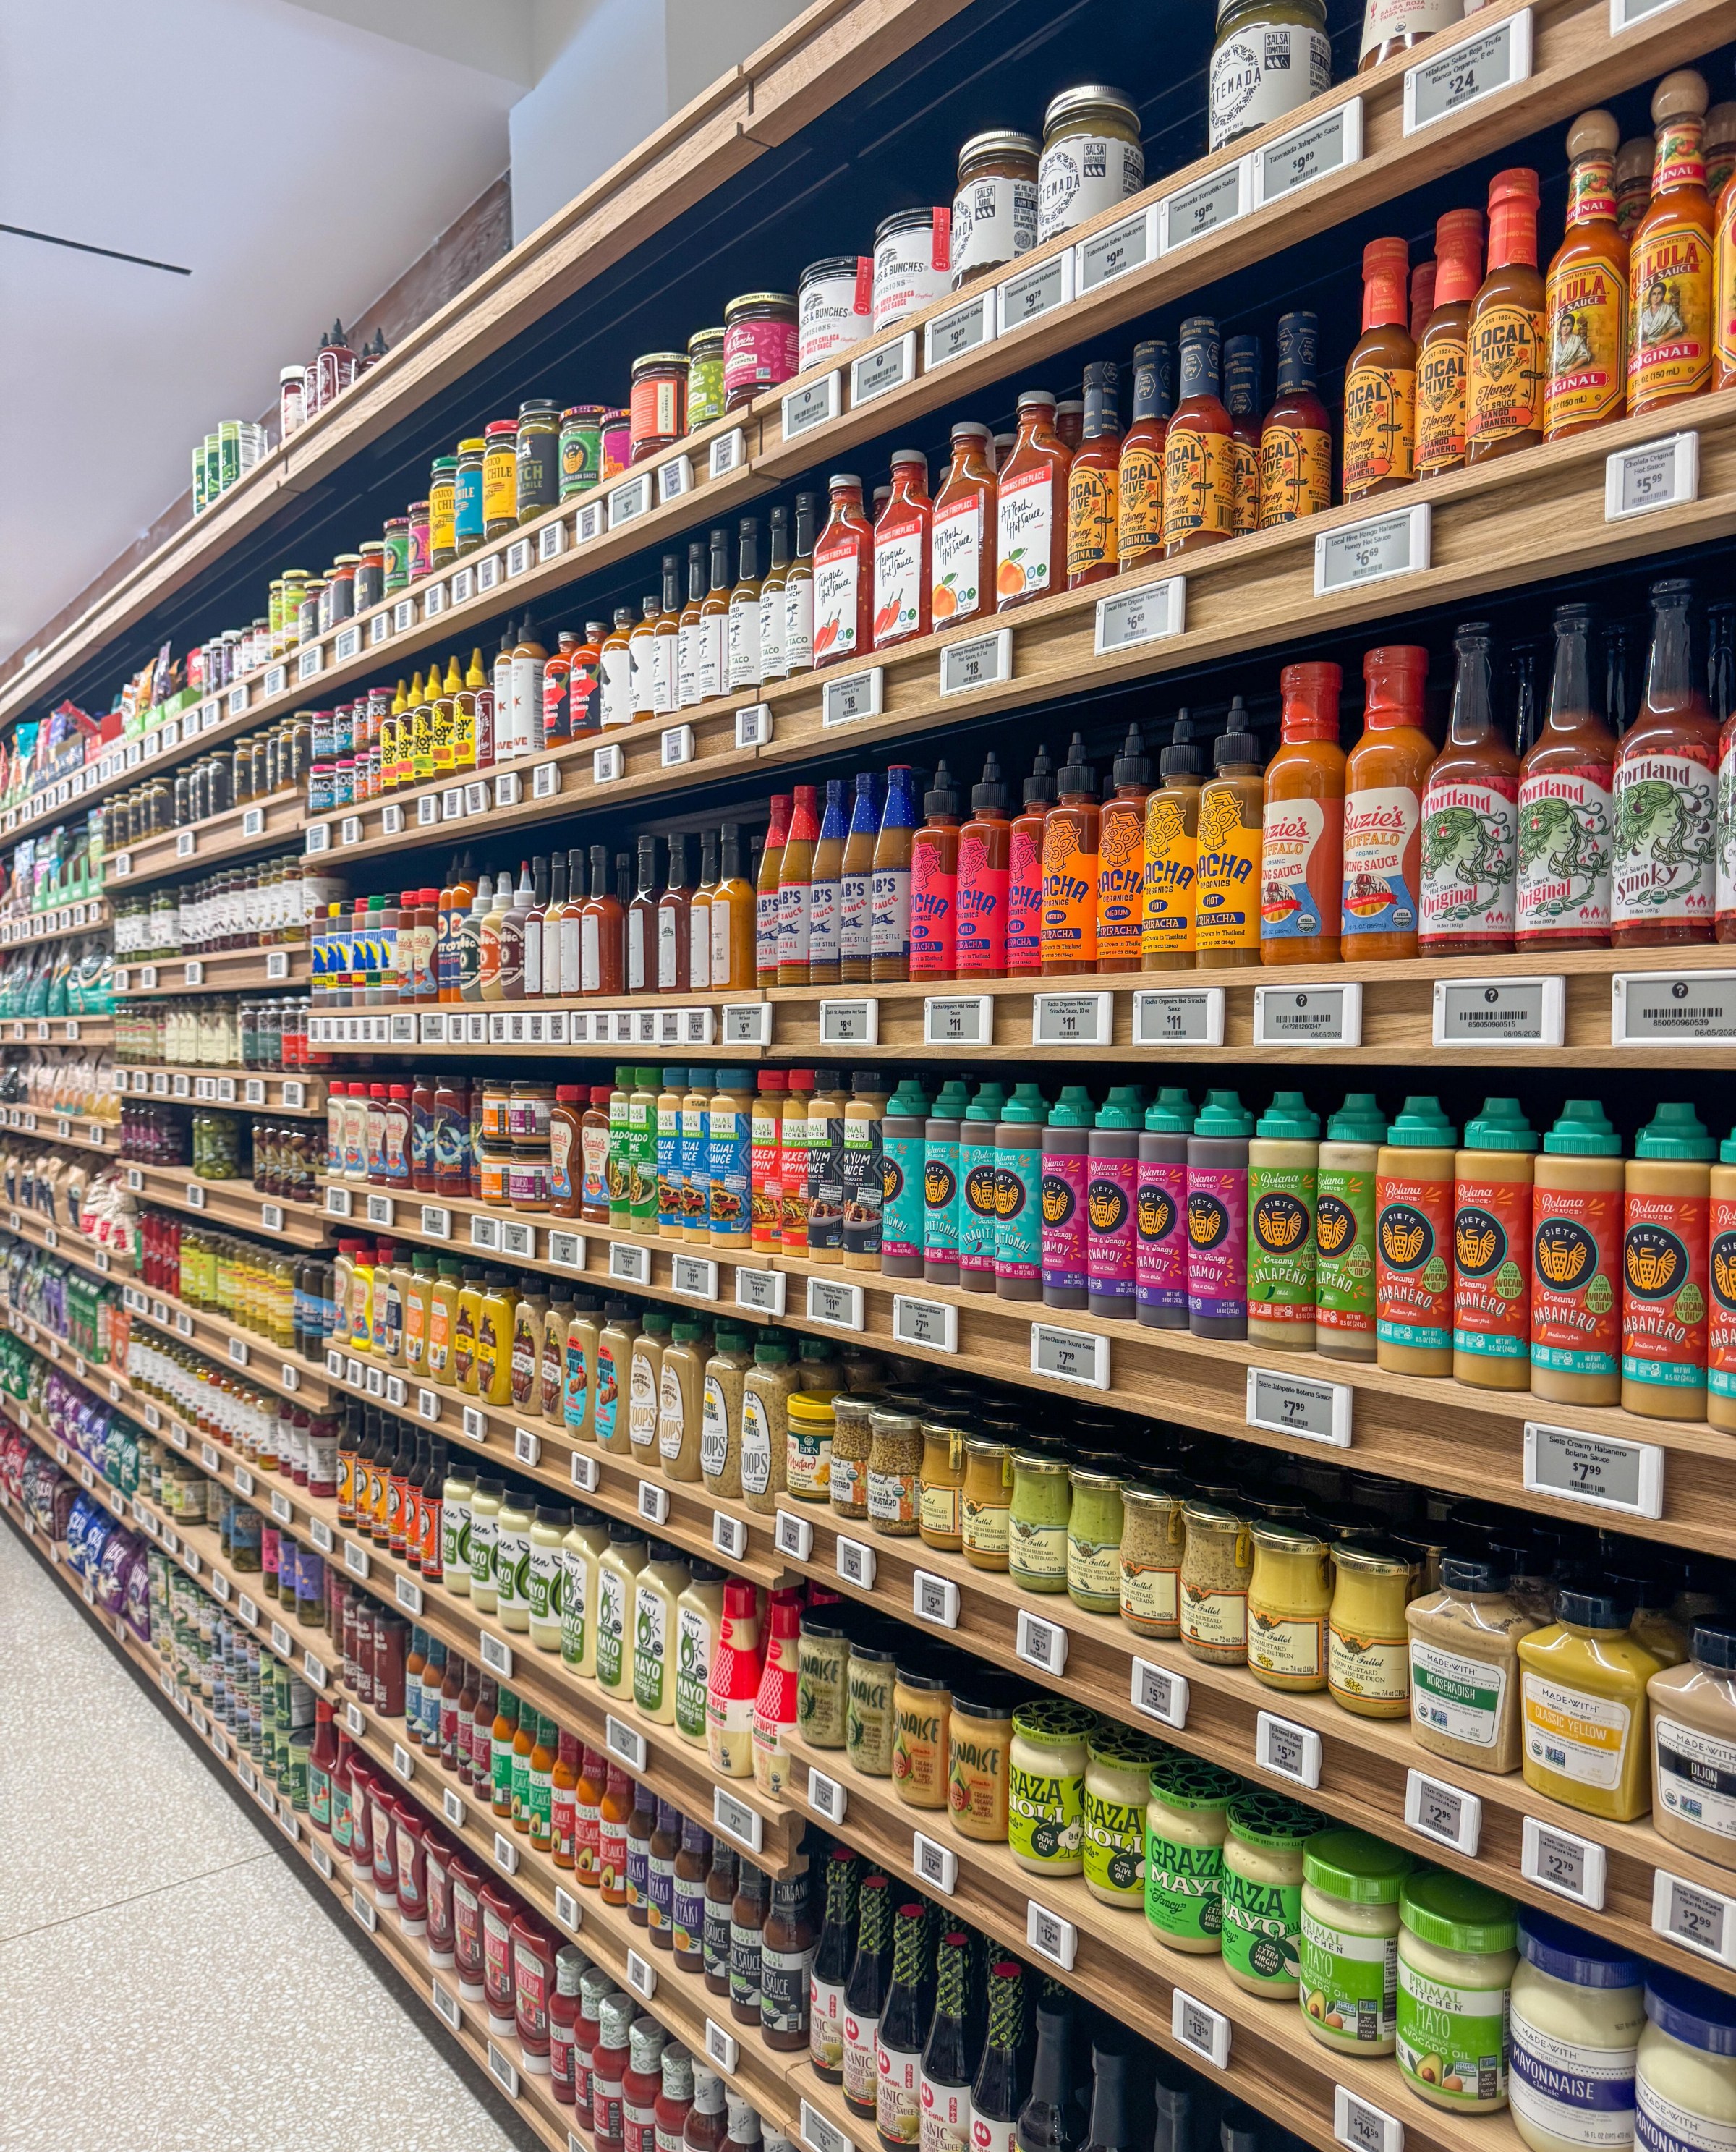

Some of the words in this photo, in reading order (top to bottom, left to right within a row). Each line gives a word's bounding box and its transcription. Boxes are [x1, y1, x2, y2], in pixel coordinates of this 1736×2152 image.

[1380, 4, 1404, 15] SALSA
[1267, 33, 1289, 46] SALSA
[1267, 46, 1289, 55] TOMATILLO
[1426, 61, 1450, 79] Milaluna
[1452, 54, 1468, 66] Salsa
[1469, 45, 1483, 56] Roja
[1485, 35, 1502, 48] Trufa
[1432, 71, 1452, 85] Blanca
[1453, 57, 1479, 74] Organic,
[1449, 69, 1474, 95] $24
[1086, 145, 1105, 156] SALSA
[1269, 144, 1297, 164] Tatemada
[1298, 132, 1323, 152] Jalapeño
[1324, 123, 1340, 139] Salsa
[977, 187, 994, 199] SALSA
[1173, 195, 1198, 213] Tatemada
[1199, 184, 1222, 203] Tomatillo
[1222, 177, 1236, 191] Salsa
[1086, 244, 1108, 259] Tatemada
[1108, 237, 1122, 250] Salsa
[1122, 224, 1145, 242] Molcajete
[1666, 237, 1690, 247] MEXICO
[889, 262, 924, 275] BUNCHES
[1008, 284, 1028, 299] Tatemada
[1039, 267, 1060, 283] Habanero
[1637, 278, 1656, 297] HOT
[1657, 264, 1692, 281] SAUCE
[815, 307, 848, 319] BUNCHES
[1549, 310, 1565, 328] HOT
[1567, 296, 1599, 311] SAUCE
[934, 320, 956, 336] Tatemada
[956, 312, 970, 326] Arbol
[970, 307, 984, 319] Salsa
[1473, 324, 1531, 357] LOCAL
[1481, 344, 1516, 363] HIVE
[1628, 344, 1691, 375] ORIGINAL
[1418, 357, 1467, 389] LOCAL
[1425, 375, 1455, 396] HIVE
[1476, 383, 1518, 406] Honey
[1348, 401, 1374, 420] HIVE
[1492, 399, 1517, 410] SAUCE
[1481, 408, 1510, 421] MANGO
[1420, 413, 1457, 436] Honey
[1475, 416, 1518, 432] HABANERO
[1419, 444, 1457, 462] HABANERO
[1625, 457, 1646, 469] Cholula
[1648, 448, 1675, 462] Original
[487, 466, 512, 480] CHILE
[1646, 460, 1666, 472] Sauce
[522, 480, 542, 490] CHILE
[1000, 480, 1018, 495] SPRINGS
[1018, 470, 1045, 487] FIREPLACE
[1119, 464, 1158, 489] LOCAL
[1122, 480, 1146, 497] HIVE
[934, 509, 949, 523] SPRINGS
[949, 499, 974, 515] FIREPLACE
[892, 523, 916, 538] FIREPLACE
[1331, 537, 1345, 547] Local
[1359, 529, 1378, 540] Mango
[1379, 522, 1407, 534] Habanero
[1118, 535, 1153, 551] ORIGINAL
[1345, 542, 1361, 551] Honey
[1374, 534, 1392, 543] Sauce
[892, 556, 914, 577] Sauce
[1129, 605, 1143, 613] Sauce
[788, 636, 809, 646] TACO
[950, 650, 964, 659] Springs
[966, 661, 979, 676] $18
[845, 695, 855, 709] $18
[1615, 760, 1690, 794] Portland
[1520, 779, 1584, 805] Portland
[1424, 788, 1491, 819] Portland
[1343, 801, 1406, 835] Suzie's
[1345, 833, 1400, 853] BUFFALO
[1355, 849, 1380, 857] ORGANIC
[1272, 863, 1303, 879] SAUCE
[1344, 860, 1363, 873] WING
[1363, 854, 1400, 871] SAUCE
[1199, 879, 1231, 890] ORGANICS
[1532, 875, 1551, 887] Sauce
[1616, 863, 1680, 906] Smoky
[876, 894, 899, 909] SAUCE
[1103, 893, 1134, 903] ORGANICS
[1205, 896, 1220, 906] HOT
[1423, 883, 1478, 919] Original
[1518, 877, 1571, 914] Original
[1046, 912, 1065, 922] MEDIUM
[1107, 908, 1128, 917] MEDIUM
[1100, 925, 1139, 937] SRIRACHA
[950, 1018, 961, 1032] $11
[1063, 1016, 1076, 1030] $11
[1167, 1014, 1182, 1029] $11
[1653, 1018, 1709, 1027] 850050960539
[710, 1153, 731, 1164] SAUCE
[852, 1154, 871, 1165] YUM
[844, 1165, 864, 1176] SAUCE
[1092, 1186, 1115, 1195] SIETE
[1264, 1200, 1295, 1211] SIETE
[1387, 1212, 1416, 1225] SIETE
[1545, 1227, 1578, 1240] SIETE
[1088, 1249, 1123, 1264] CHAMOY
[1263, 1254, 1295, 1268] Creamy
[1254, 1266, 1308, 1288] JALAPEÑO
[1377, 1288, 1433, 1310] HABANERO
[1542, 1290, 1578, 1307] Creamy
[1584, 1292, 1614, 1303] AVOCADO
[1534, 1308, 1597, 1333] HABANERO
[1623, 1314, 1686, 1343] HABANERO
[1259, 1380, 1272, 1389] Siete
[1272, 1382, 1295, 1395] Jalapeño
[1295, 1388, 1315, 1398] Botana
[1316, 1392, 1332, 1401] Sauce
[799, 1444, 820, 1456] EDEN
[1549, 1435, 1565, 1445] Siete
[1567, 1439, 1592, 1452] Creamy
[1594, 1445, 1627, 1458] Habanero
[787, 1453, 817, 1472] Mustard
[1565, 1448, 1588, 1459] Botana
[1589, 1453, 1610, 1463] Sauce
[634, 1651, 661, 1680] MAYO
[1348, 1663, 1379, 1677] MUSTARD
[1356, 1655, 1384, 1668] Fallot
[1365, 1674, 1386, 1684] DIJON
[1426, 1672, 1476, 1701] HORSERADISH
[677, 1675, 705, 1705] MAYO
[1535, 1705, 1565, 1730] CLASSIC
[1568, 1714, 1607, 1742] YELLOW
[1691, 1761, 1719, 1784] DIJON
[1691, 1776, 1717, 1789] mustard
[1037, 1833, 1055, 1848] OLIVE
[1038, 1842, 1048, 1852] OIL
[1303, 1914, 1343, 1947] PRIMAL
[1254, 1953, 1279, 1970] VIRGIN
[1256, 1944, 1280, 1962] EXTRA
[1306, 1940, 1333, 1978] MAYO
[769, 1978, 788, 1996] SAUCE
[1409, 1973, 1463, 2005] PRIMAL
[1409, 1984, 1463, 2013] KITCHEN
[1415, 2001, 1451, 2039] MAYO
[1403, 2025, 1448, 2057] AVOCADO
[1451, 2049, 1471, 2061] OIL
[1534, 2049, 1560, 2067] organic
[1512, 2041, 1595, 2101] MAYONNAISE
[1532, 2079, 1560, 2098] classic
